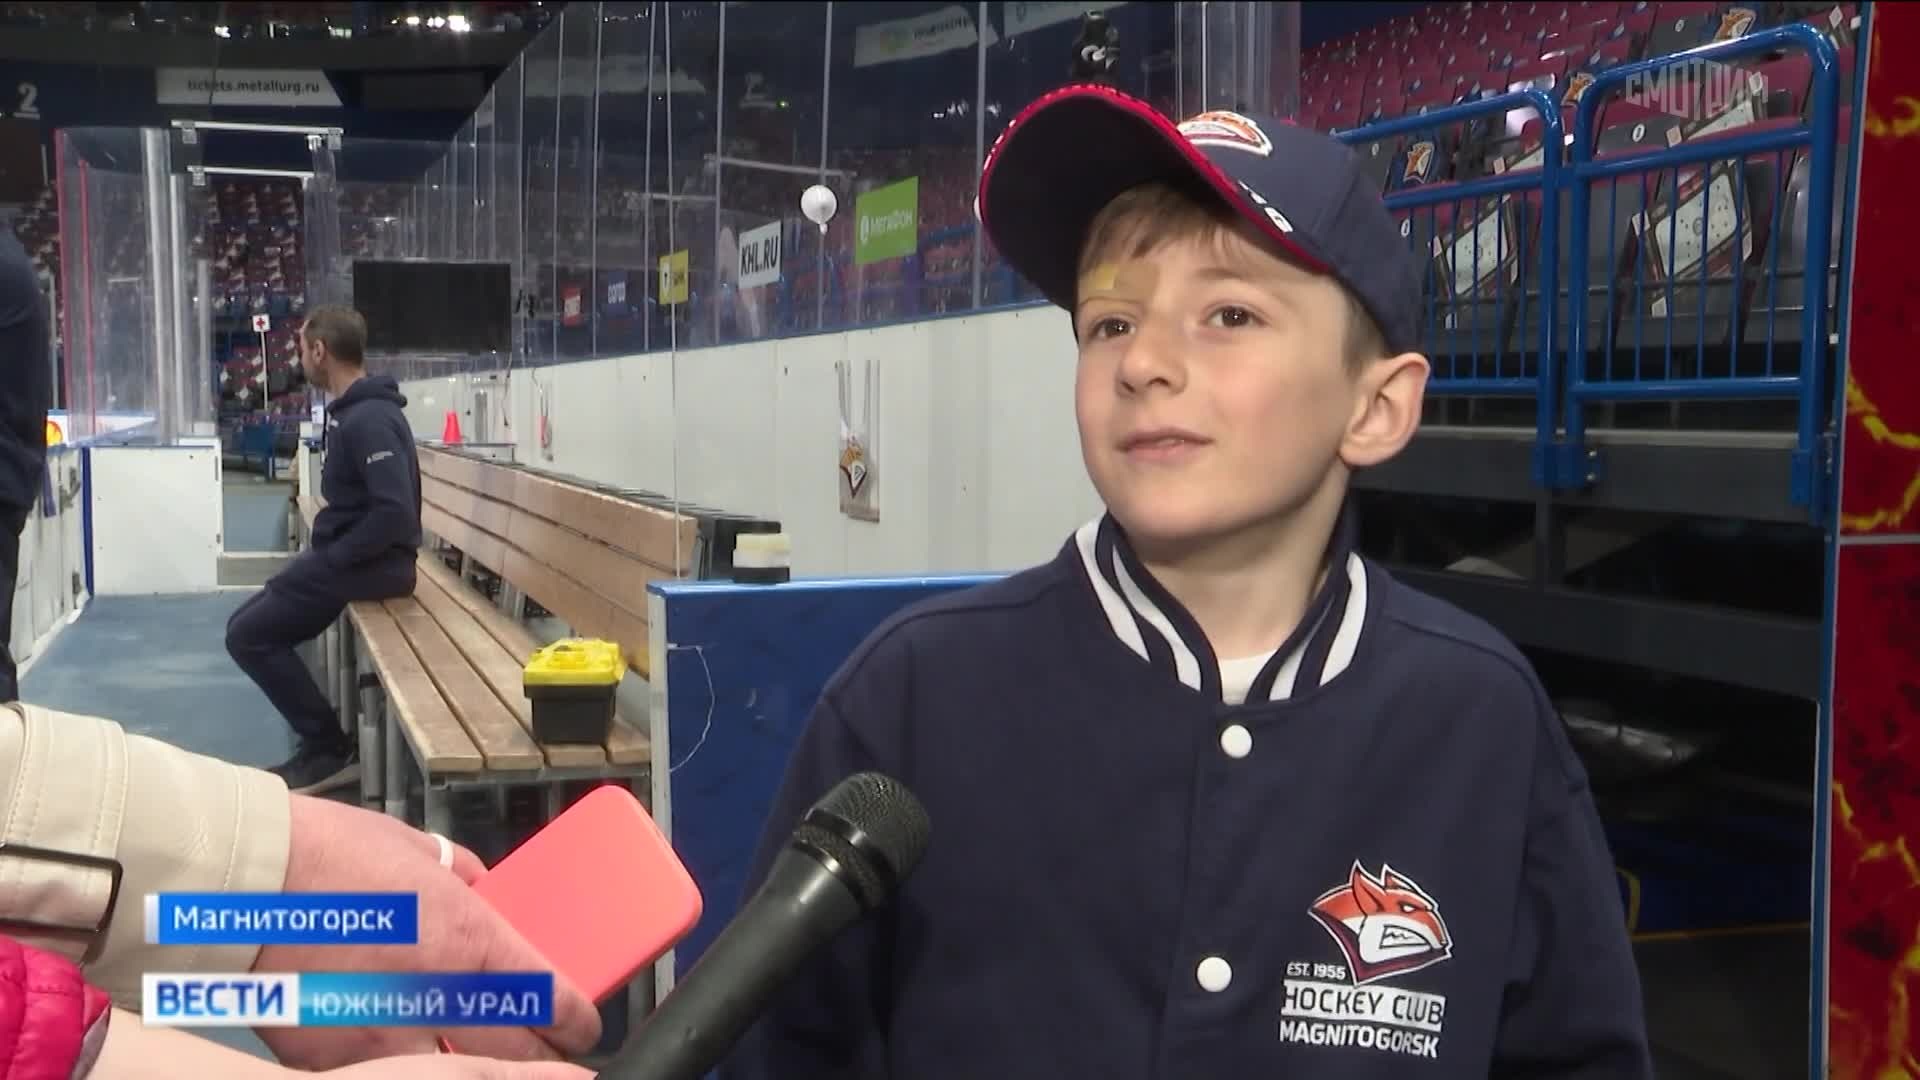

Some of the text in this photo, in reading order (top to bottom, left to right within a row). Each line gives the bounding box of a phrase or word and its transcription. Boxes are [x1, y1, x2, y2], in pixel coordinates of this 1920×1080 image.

[18, 82, 38, 112] 2
[187, 80, 320, 95] tickets.metallurg.ru
[740, 236, 778, 276] KHL.RU
[1287, 961, 1346, 980] EST. 1955
[1283, 984, 1443, 1025] HOCKEY CLUB
[1280, 1020, 1439, 1058] MAGNITOGORSK
